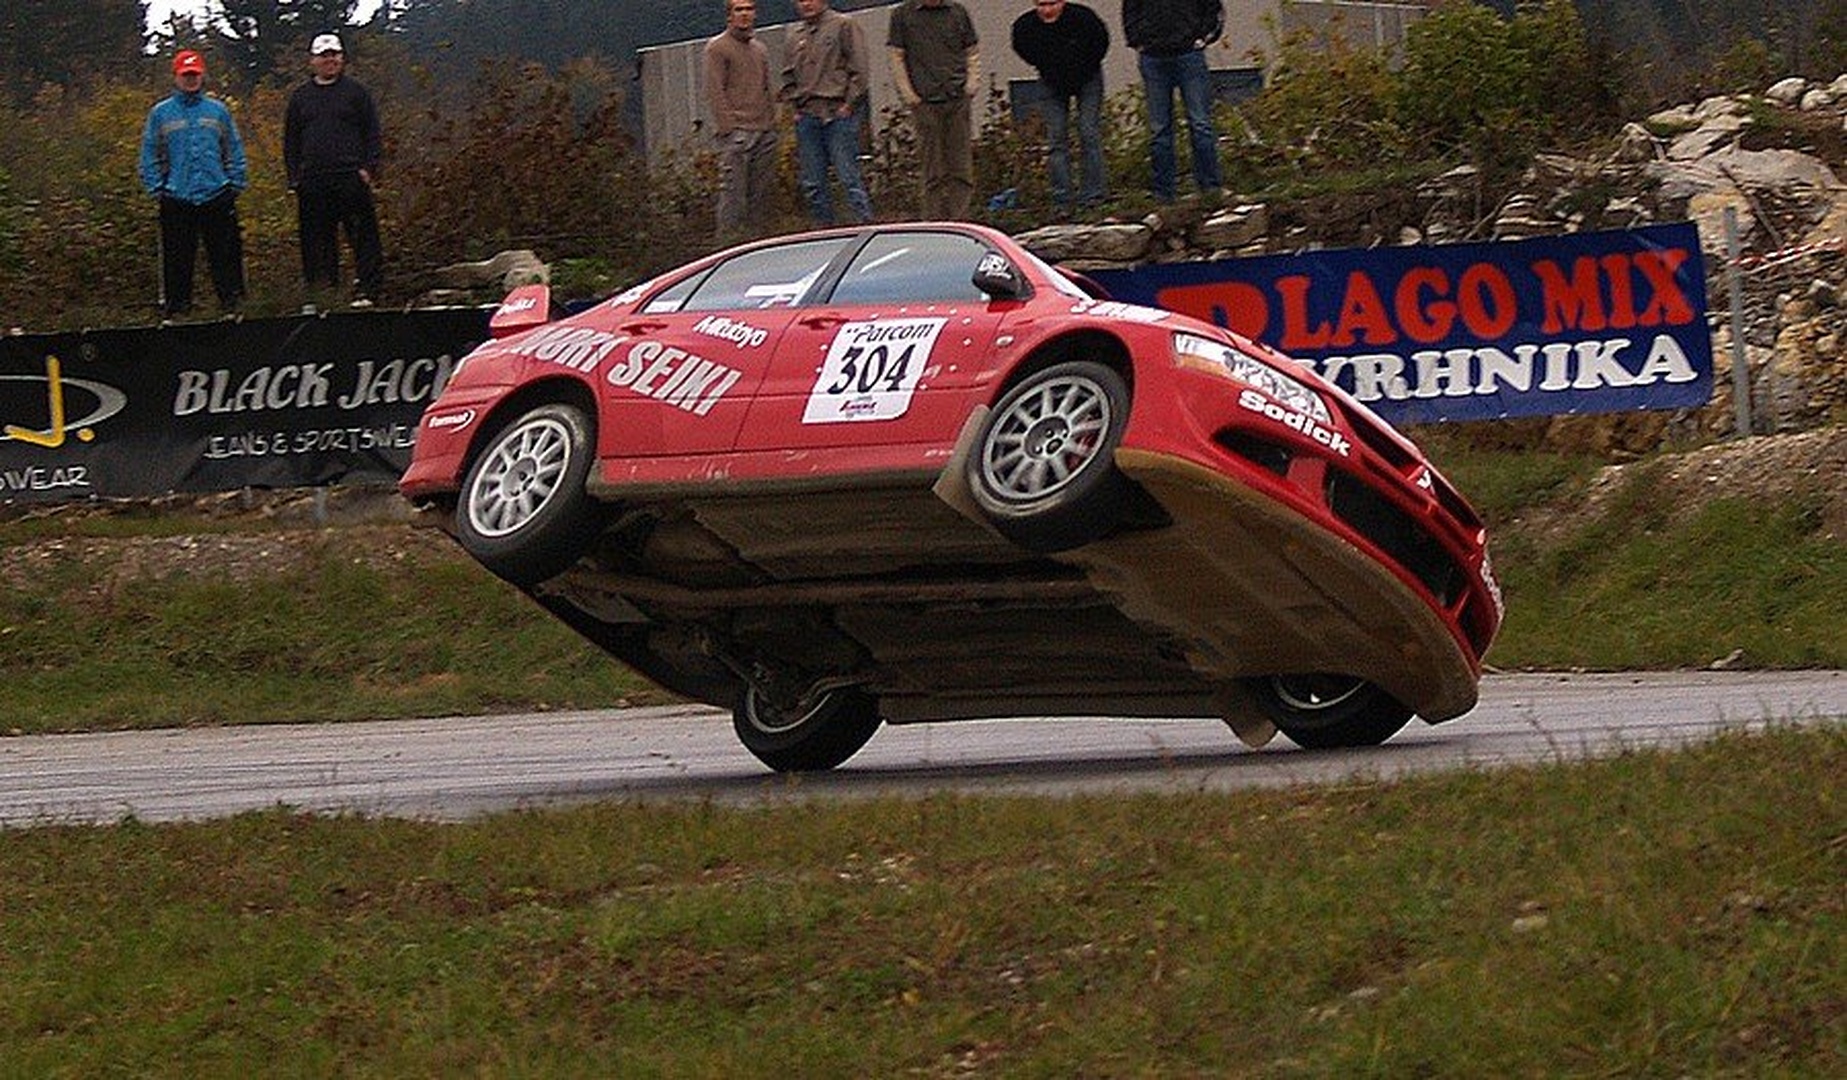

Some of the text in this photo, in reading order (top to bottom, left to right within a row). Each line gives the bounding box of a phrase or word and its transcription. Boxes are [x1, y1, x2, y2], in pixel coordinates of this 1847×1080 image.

[1531, 248, 1696, 335] MIX
[174, 362, 335, 416] BLACK
[606, 341, 742, 417] SEIKI
[827, 343, 917, 395] 304
[271, 432, 289, 454] &
[1238, 389, 1351, 457] Sodick
